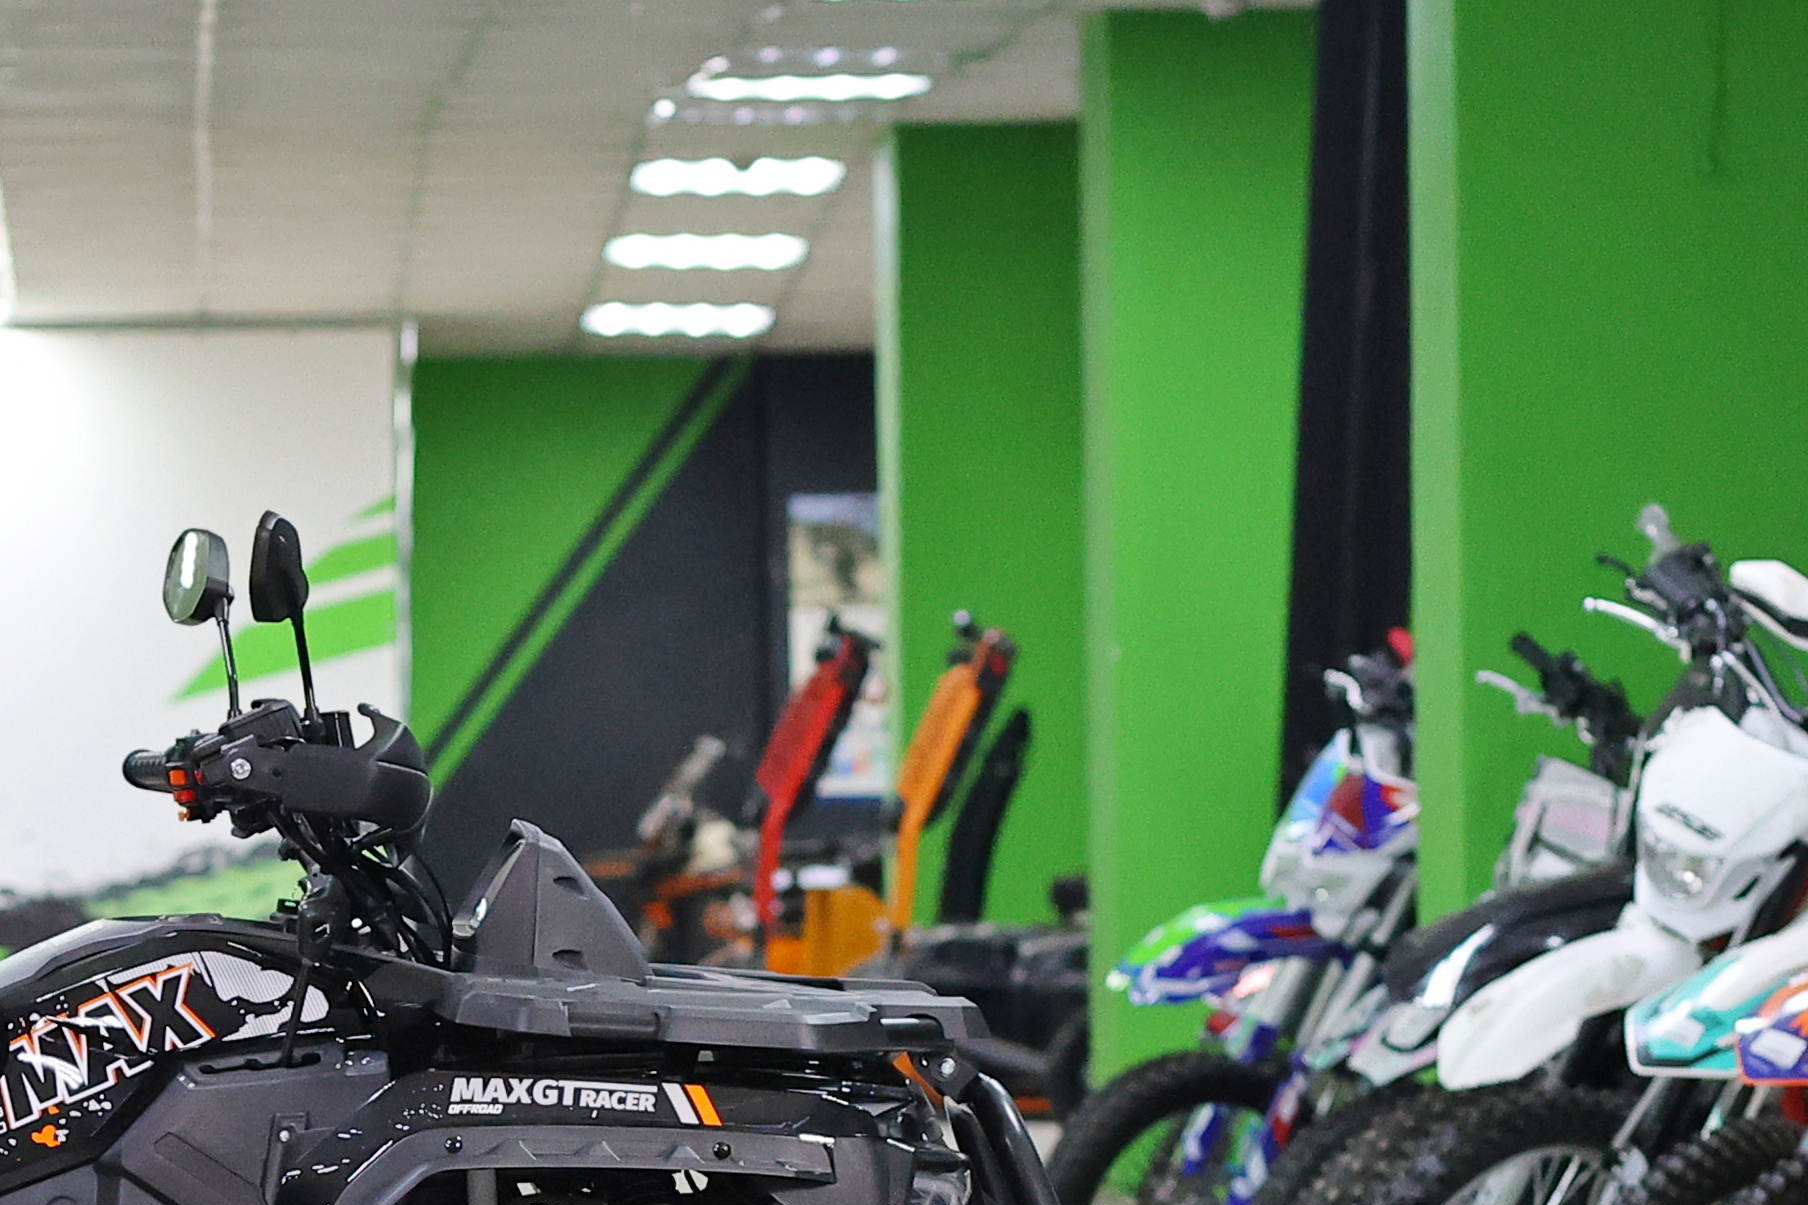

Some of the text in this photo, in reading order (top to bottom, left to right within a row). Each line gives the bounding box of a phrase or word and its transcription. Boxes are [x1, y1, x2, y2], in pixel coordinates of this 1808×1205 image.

[0, 962, 217, 1130] MAX
[447, 1103, 504, 1115] OFFROAD
[578, 1088, 657, 1113] RACER
